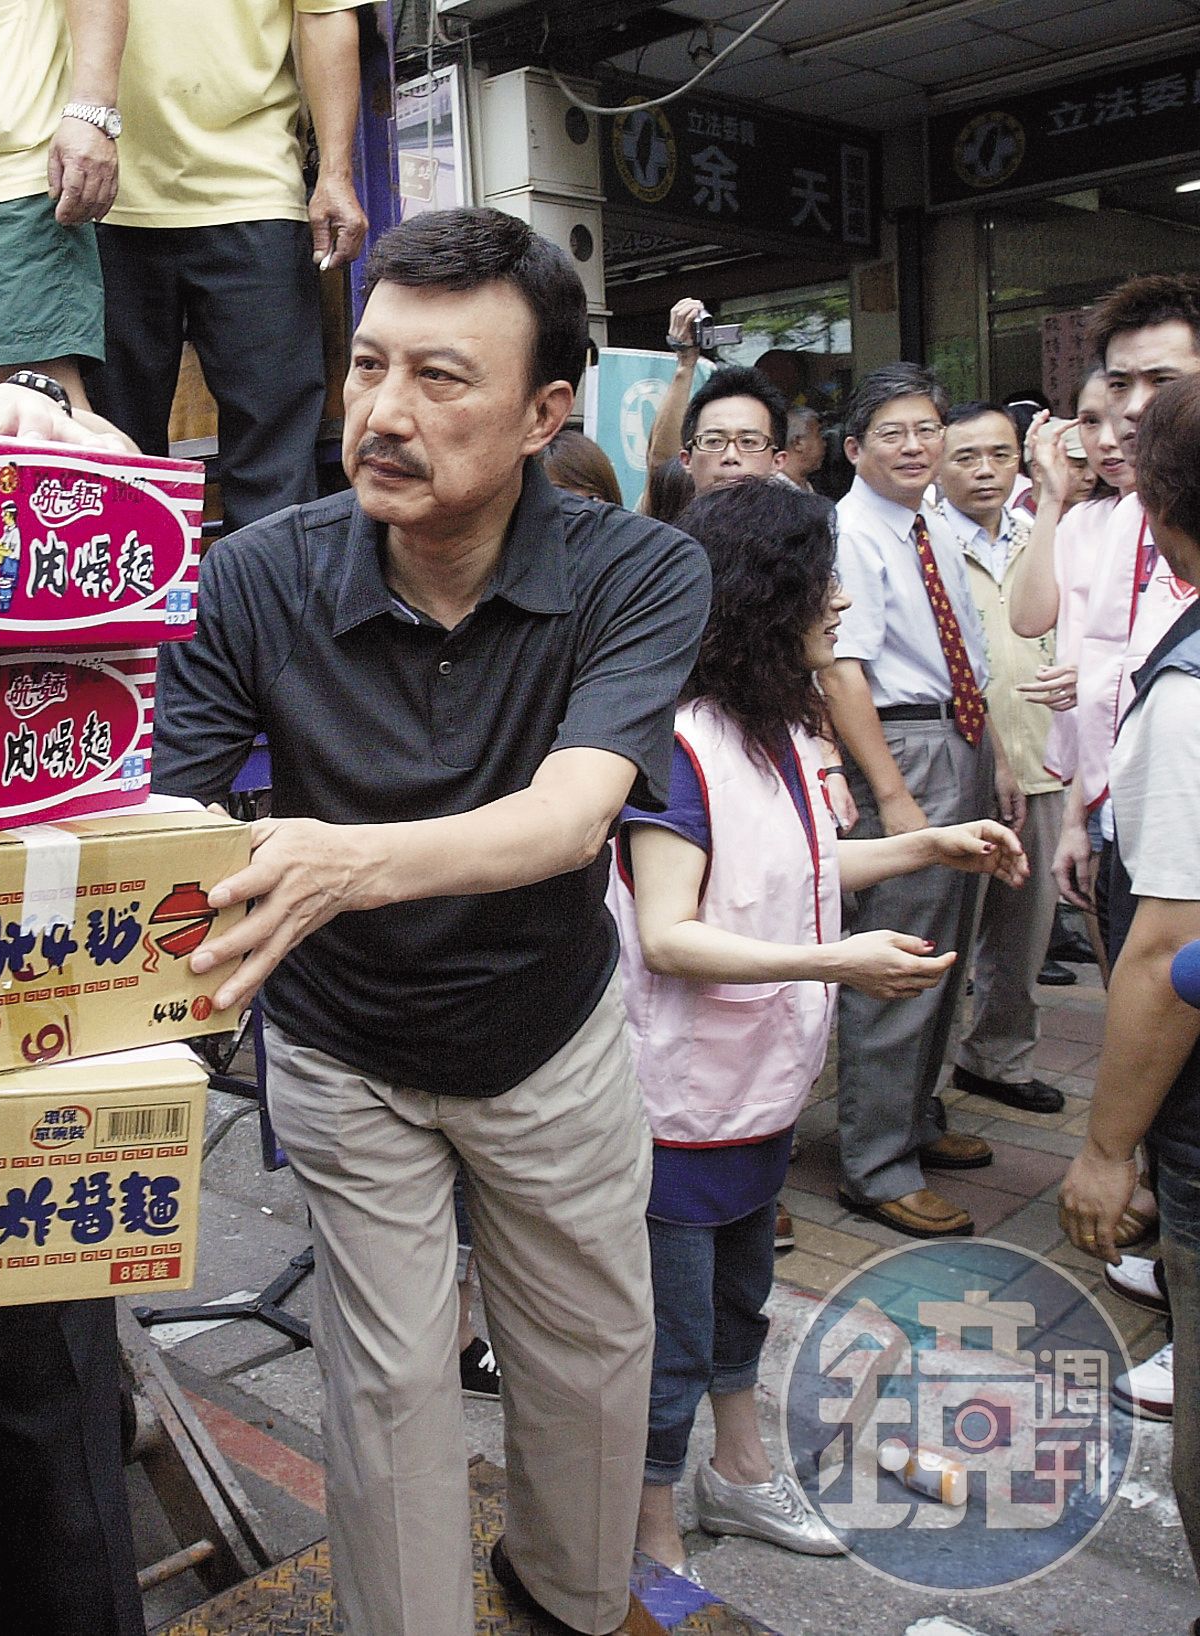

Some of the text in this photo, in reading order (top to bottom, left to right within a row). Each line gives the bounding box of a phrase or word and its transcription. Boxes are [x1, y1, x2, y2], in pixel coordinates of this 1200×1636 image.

[1046, 70, 1200, 136] 立法委
[691, 145, 832, 232] 余天
[26, 530, 155, 602] 肉燥麵
[1, 709, 113, 787] 肉燥麵
[42, 1109, 78, 1125] 環保
[119, 1262, 169, 1281] 8碗裝
